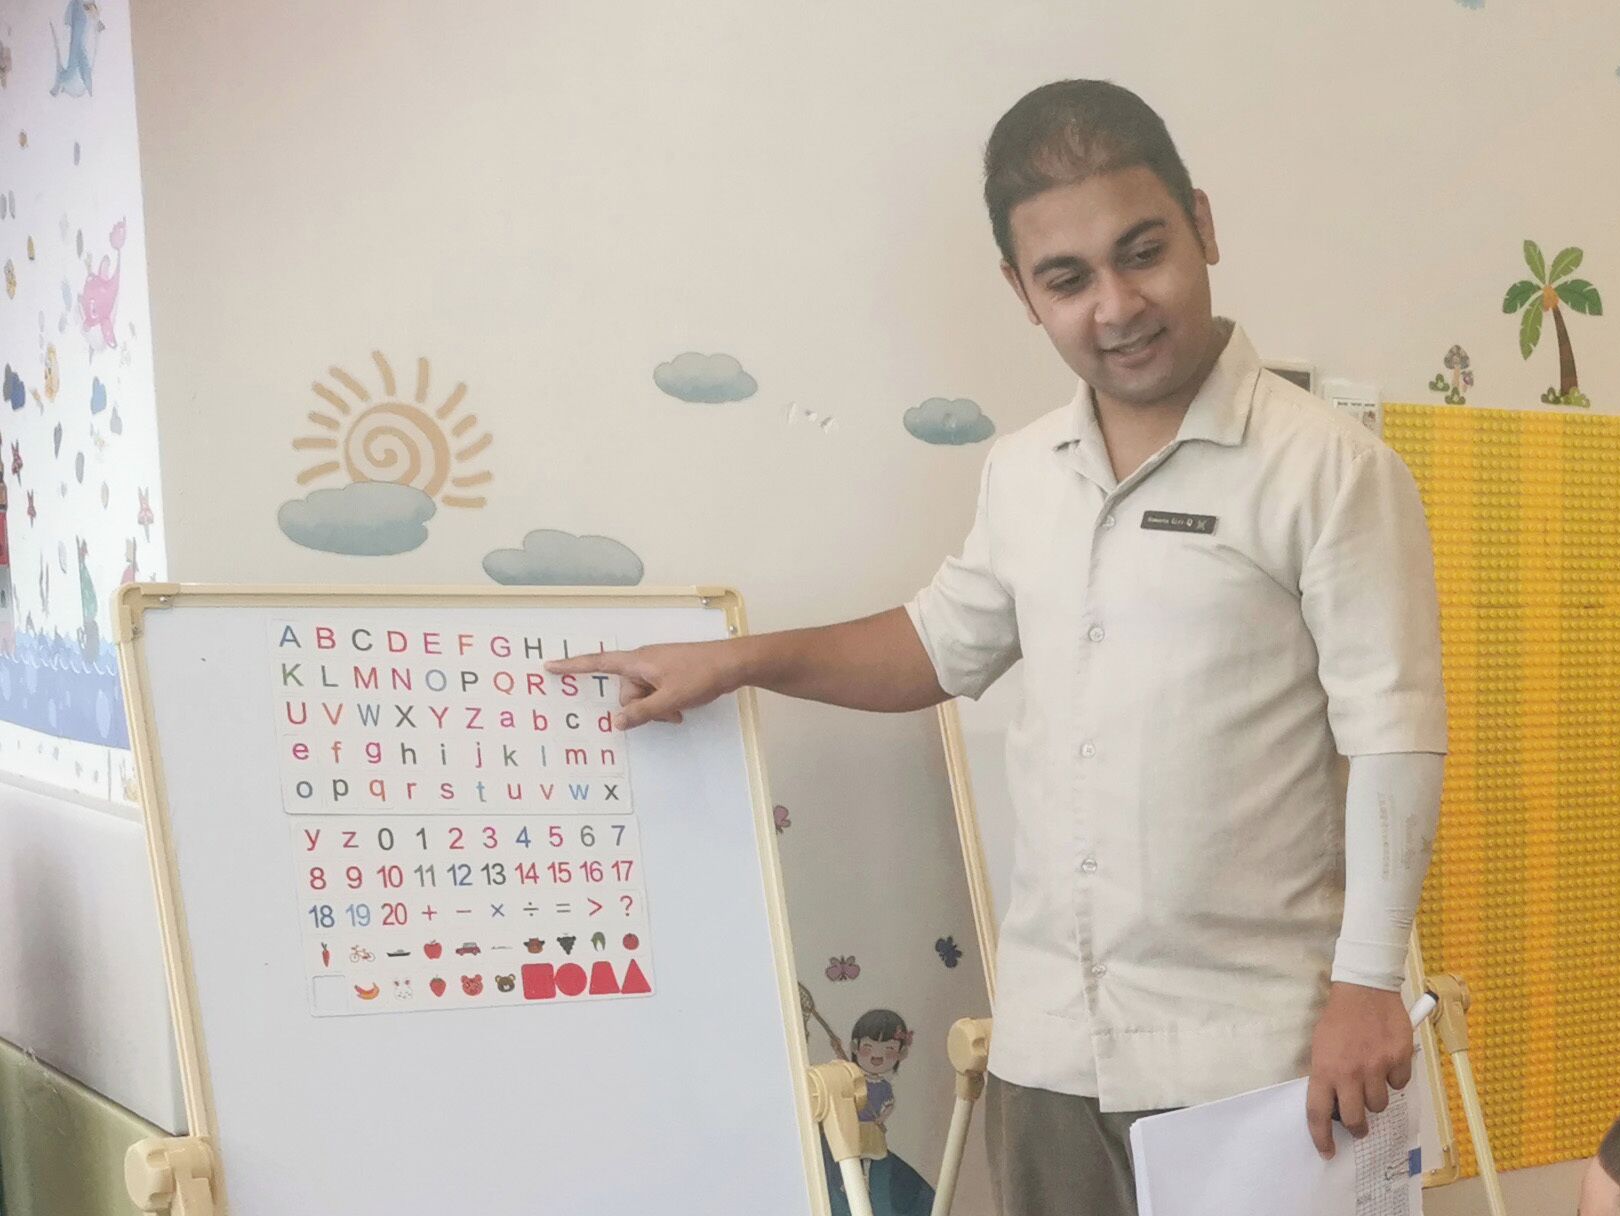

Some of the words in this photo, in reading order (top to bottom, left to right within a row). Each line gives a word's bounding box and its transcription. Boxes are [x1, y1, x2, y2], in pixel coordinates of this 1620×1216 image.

[278, 624, 302, 649] A
[315, 626, 337, 650] B
[351, 628, 374, 652] C
[386, 630, 409, 653] D
[422, 631, 443, 656] E
[457, 633, 474, 656] F
[489, 635, 512, 658] G
[523, 636, 544, 660] H
[281, 662, 305, 687] K
[320, 664, 339, 688] L
[352, 665, 379, 690] M
[390, 667, 413, 691] N
[425, 668, 448, 692] O
[460, 670, 479, 693] P
[492, 670, 516, 696] Q
[525, 672, 547, 696] R
[560, 673, 579, 697] S
[591, 674, 609, 698] T
[285, 700, 308, 726] U
[321, 702, 344, 726] V
[356, 703, 381, 728] W
[394, 704, 417, 729] X
[428, 705, 450, 730] Y
[464, 706, 485, 730] Z
[499, 710, 516, 729] a
[532, 708, 549, 732] b
[565, 712, 580, 730] c
[597, 710, 614, 733] d
[291, 742, 310, 761] e
[330, 740, 342, 764] f
[364, 741, 382, 765] g
[400, 741, 418, 765] h
[440, 742, 447, 766] i
[475, 741, 483, 769] j
[502, 744, 519, 767] k
[564, 748, 588, 767] m
[600, 748, 616, 766] n
[295, 780, 314, 799] o
[331, 778, 350, 802] p
[368, 778, 387, 803] q
[406, 782, 417, 800] r
[440, 782, 455, 800] s
[475, 780, 487, 803] t
[506, 783, 523, 801] u
[539, 783, 555, 801] v
[568, 783, 590, 801] w
[603, 783, 620, 801] x
[303, 828, 321, 852] y
[341, 830, 360, 849] z
[377, 827, 395, 852] 0
[415, 826, 428, 851] 1
[447, 826, 465, 850] 2
[482, 825, 499, 850] 3
[514, 825, 532, 849] 4
[548, 825, 564, 848] 5
[580, 824, 596, 848] 6
[610, 824, 626, 847] 7
[309, 866, 327, 891] 8
[345, 865, 363, 890] 9
[376, 864, 405, 889] 10
[413, 863, 437, 888] 11
[446, 863, 474, 887] 12
[480, 862, 507, 886] 13
[514, 861, 541, 885] 14
[546, 861, 573, 884] 15
[578, 860, 604, 883] 16
[610, 859, 634, 882] 17
[308, 904, 336, 929] 18
[345, 903, 371, 928] 19
[380, 901, 409, 928] 20
